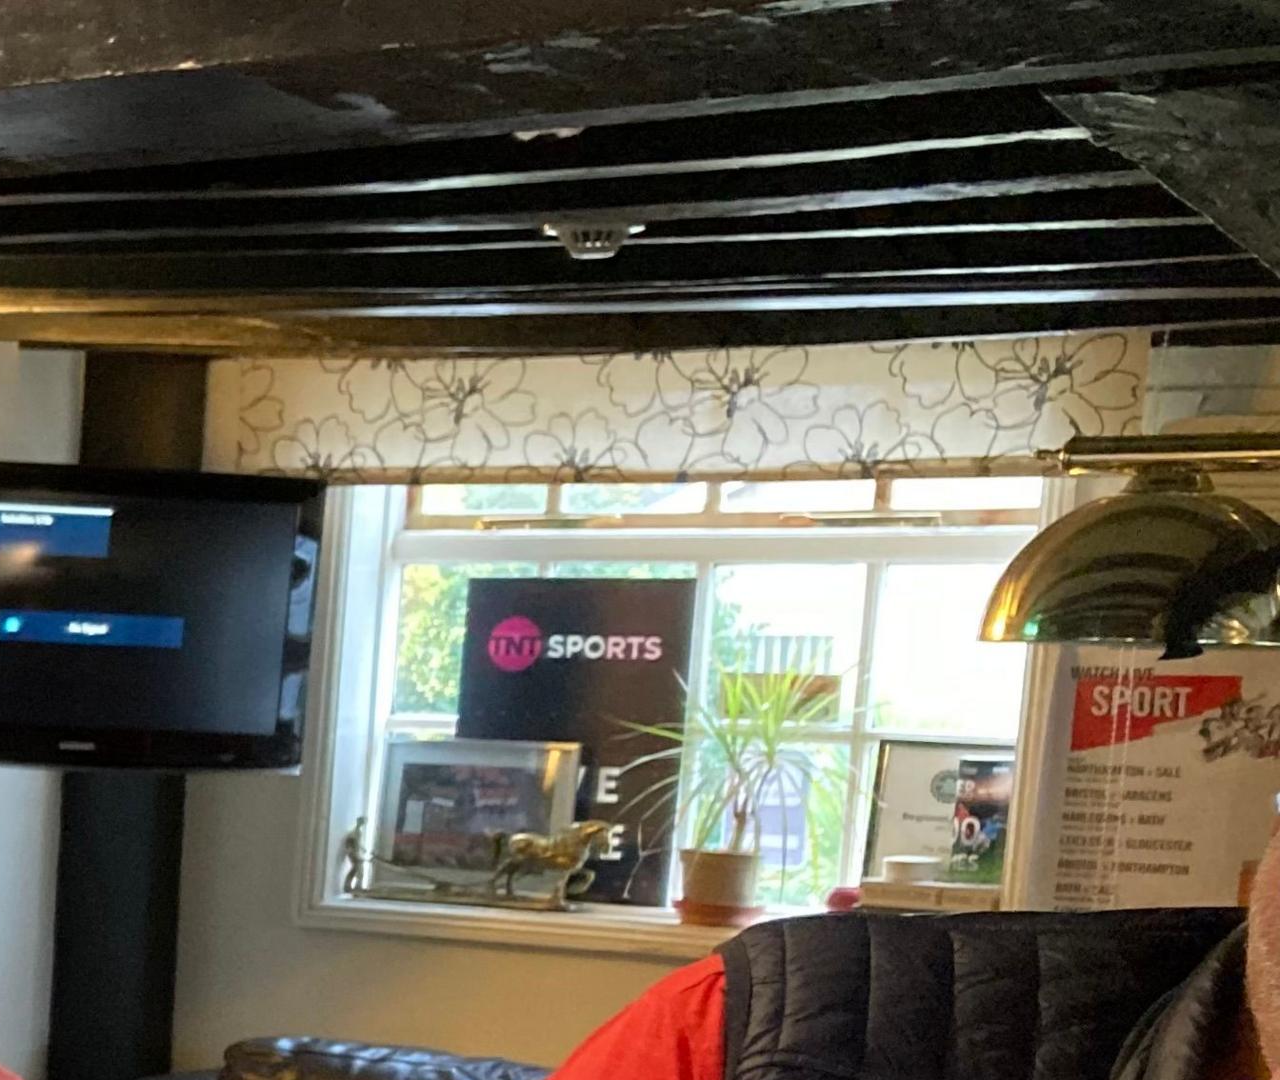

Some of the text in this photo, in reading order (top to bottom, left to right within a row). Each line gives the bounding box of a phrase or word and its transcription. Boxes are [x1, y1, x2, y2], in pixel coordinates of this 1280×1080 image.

[490, 634, 663, 661] TNT SPORTS
[1090, 685, 1193, 718] SPORT
